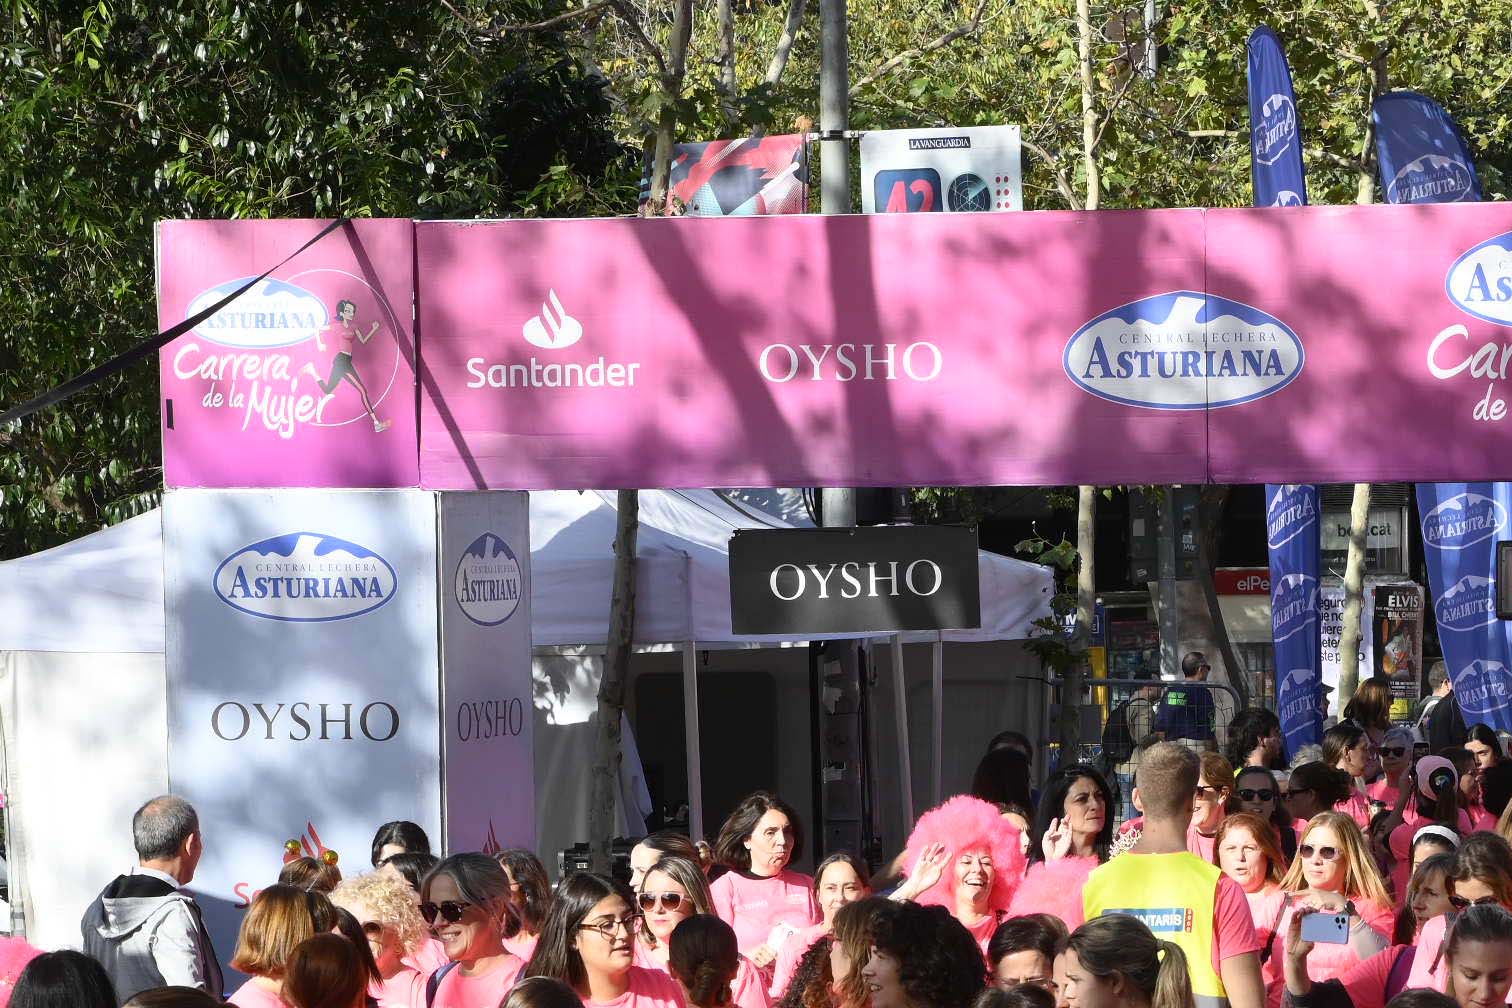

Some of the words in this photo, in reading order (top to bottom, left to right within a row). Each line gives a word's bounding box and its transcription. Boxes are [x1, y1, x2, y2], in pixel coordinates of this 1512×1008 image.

[1119, 333, 1194, 344] CENTRAL
[1202, 331, 1277, 342] LECHERA
[173, 343, 292, 381] Carrera
[467, 357, 640, 388] Santander
[759, 342, 943, 382] OYSHO
[1082, 336, 1285, 379] ASTURIANA
[202, 383, 223, 408] de
[229, 382, 244, 408] la
[242, 378, 335, 439] Mujer
[1472, 383, 1507, 421] de
[228, 565, 384, 599] ASTURIANA
[255, 563, 313, 573] CENTRAL
[319, 562, 378, 572] LECHERA
[461, 568, 518, 604] ASTURIANA
[769, 559, 942, 601] OYSHO
[1388, 595, 1419, 608] ELVIS
[211, 701, 400, 741] OYSHO
[457, 698, 523, 742] OYSHO
